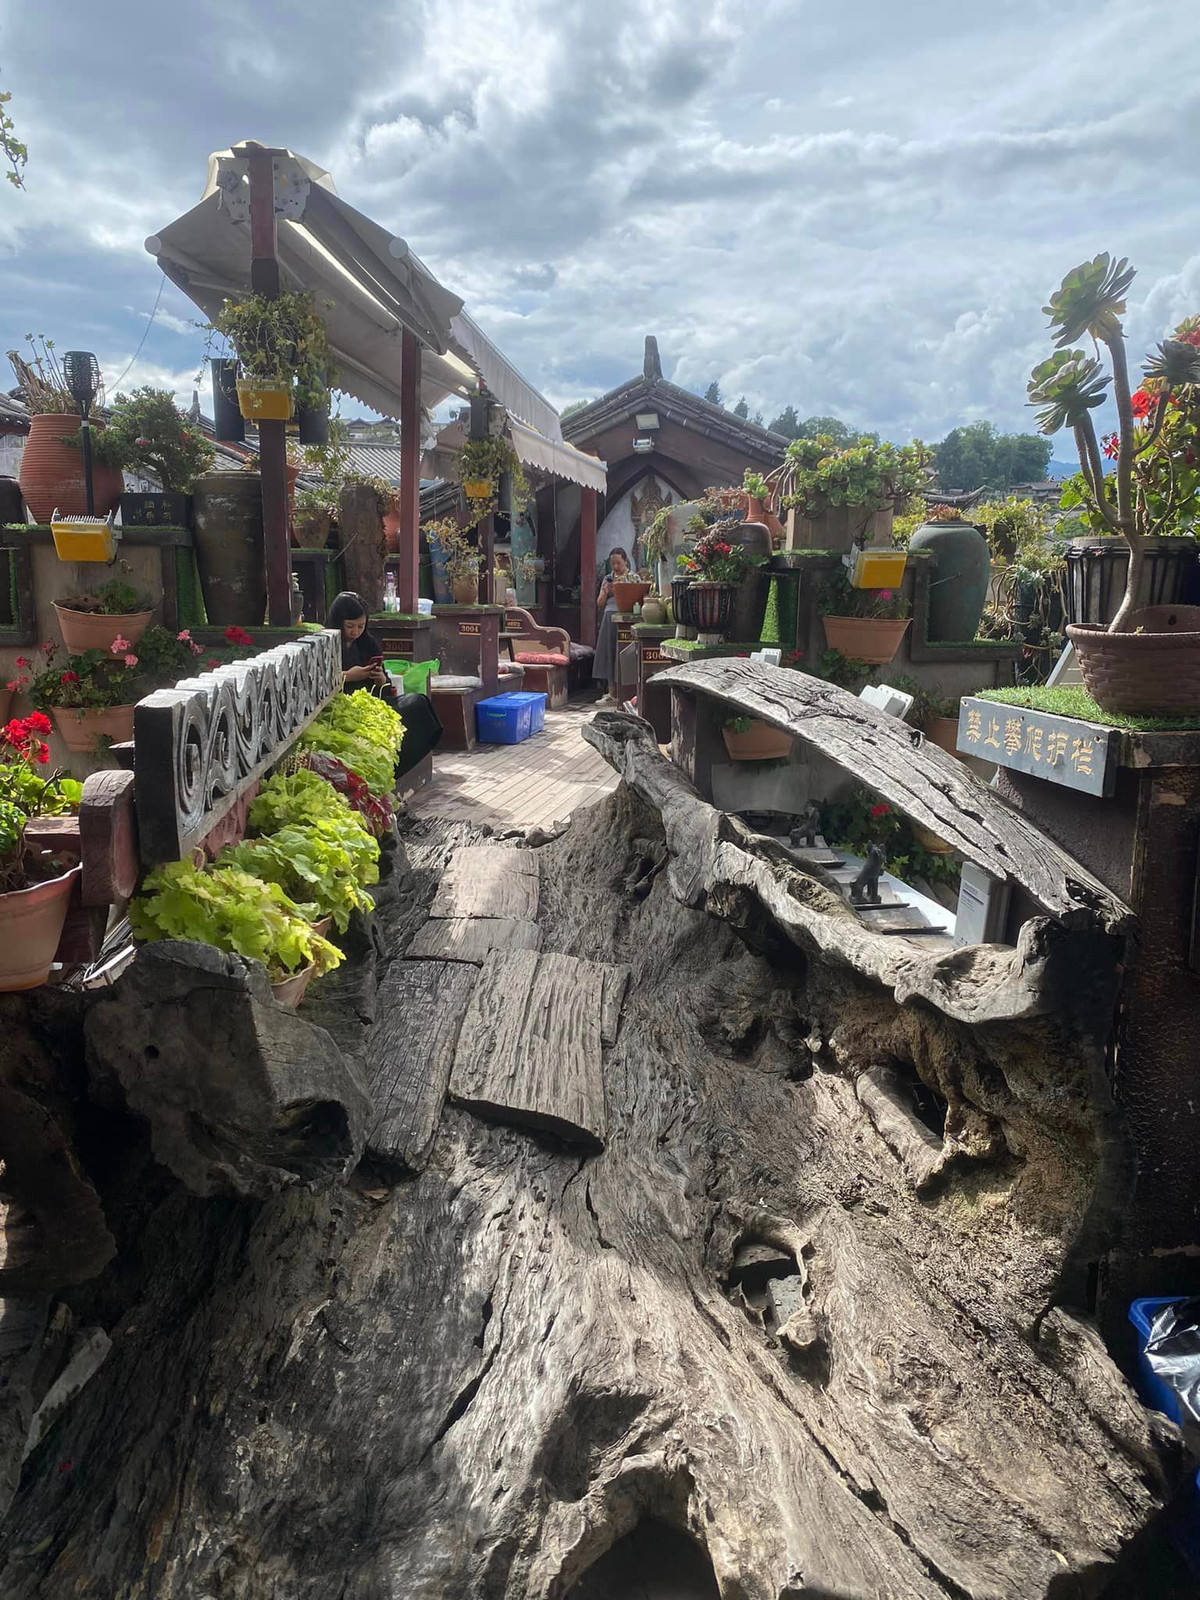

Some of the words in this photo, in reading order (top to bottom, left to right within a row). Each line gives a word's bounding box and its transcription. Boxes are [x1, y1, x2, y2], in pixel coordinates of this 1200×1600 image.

[460, 625, 479, 633] 3004
[965, 708, 1094, 776] 禁止攀爬护栏
